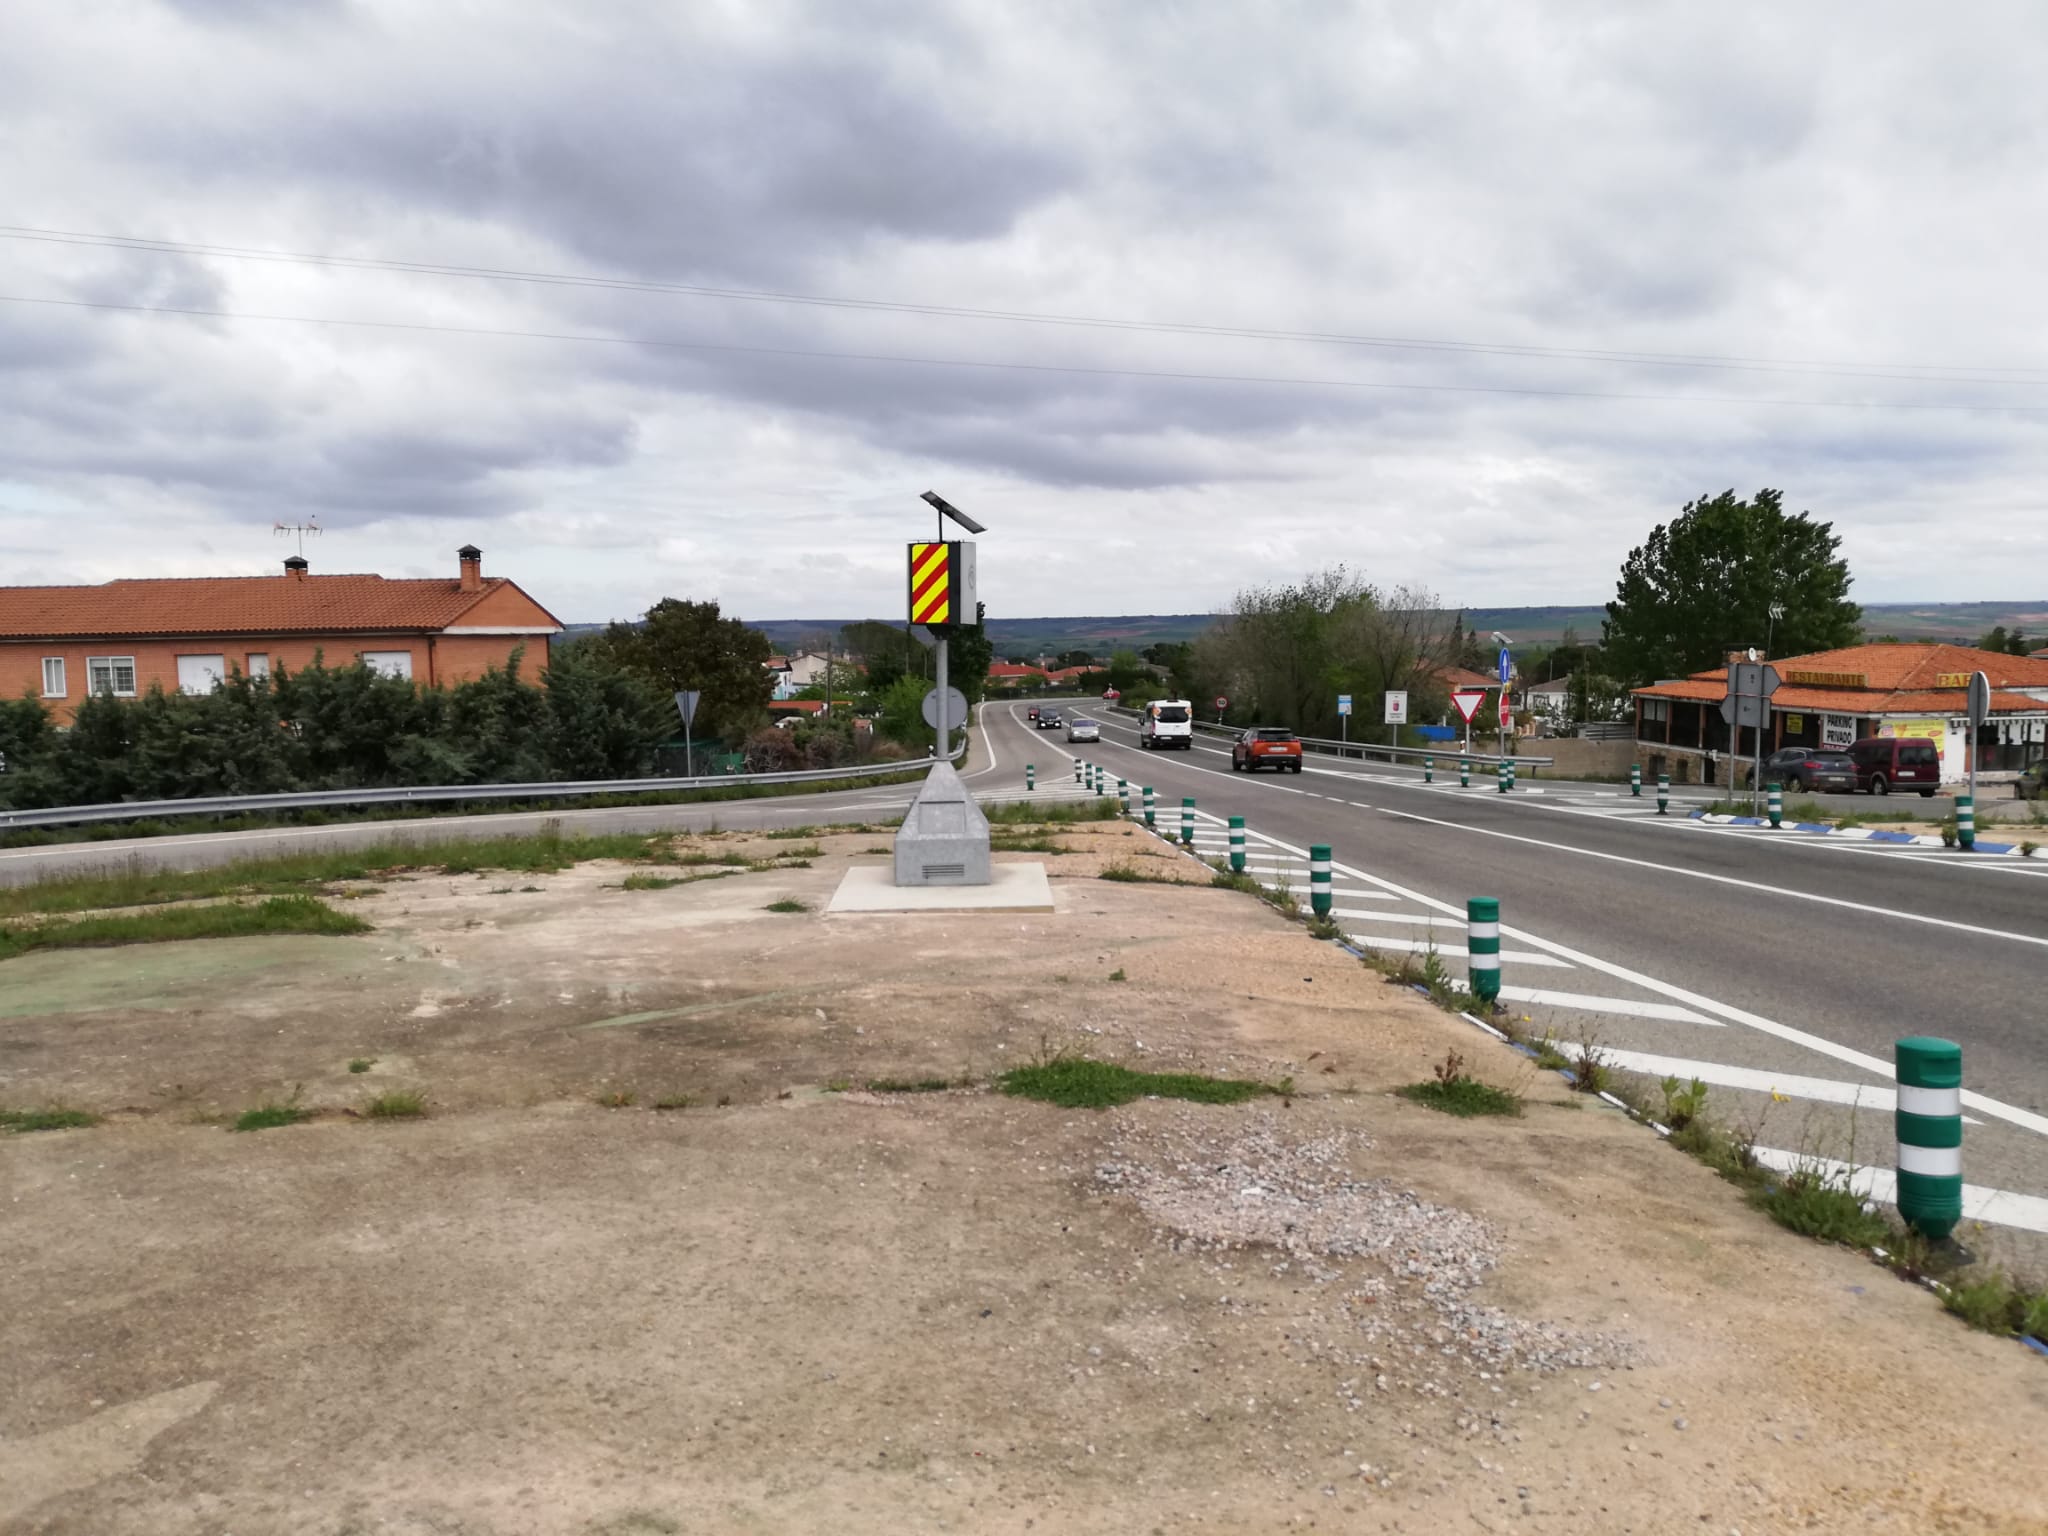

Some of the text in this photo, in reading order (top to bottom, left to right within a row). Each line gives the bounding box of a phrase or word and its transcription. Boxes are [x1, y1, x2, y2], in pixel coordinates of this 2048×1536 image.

[1786, 671, 1865, 687] RESTAURANTE
[1827, 714, 1852, 728] PARKING
[1827, 730, 1852, 744] PRIVADO
